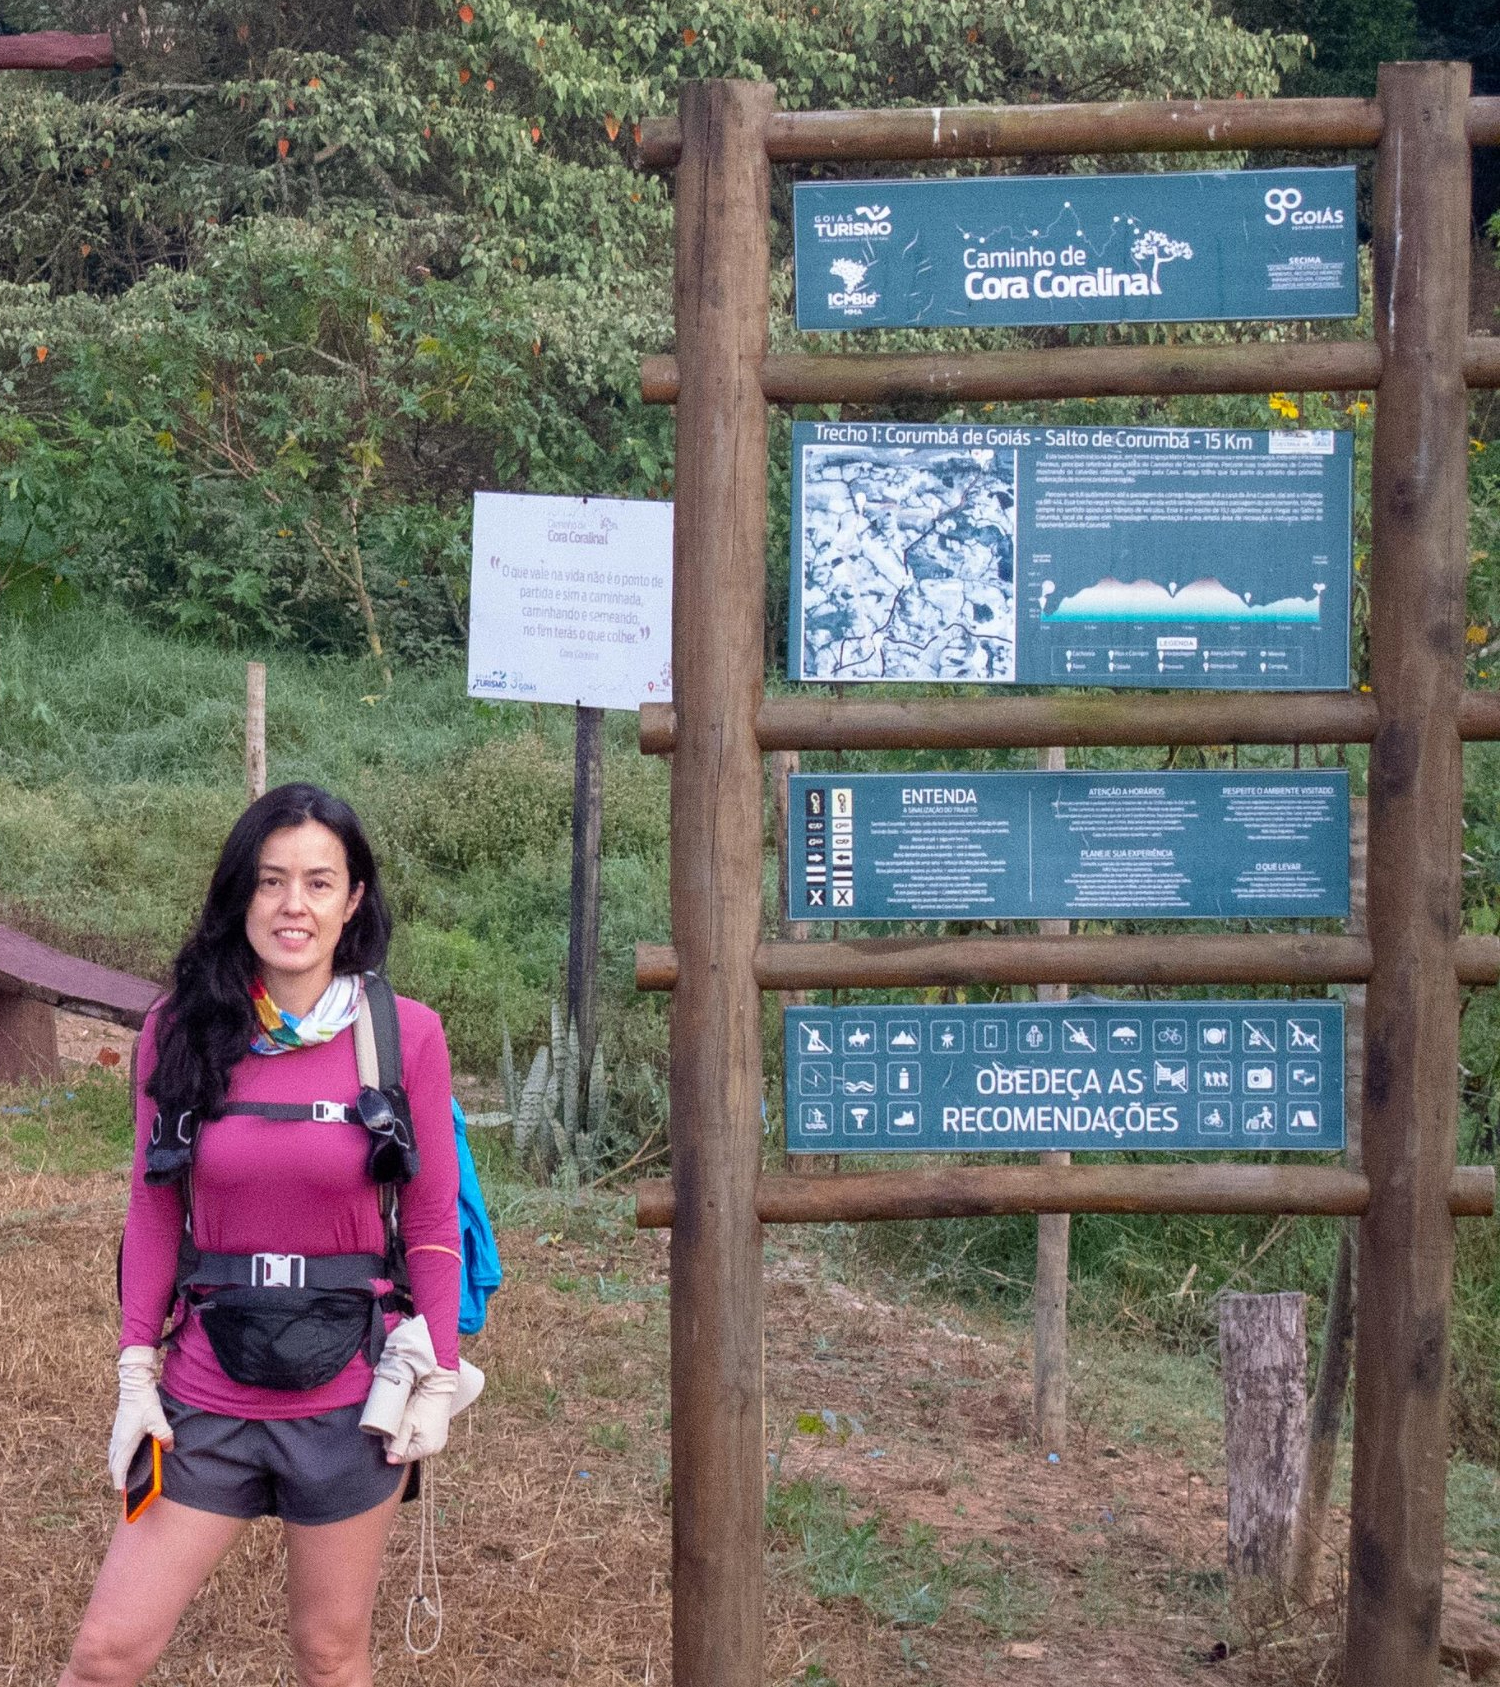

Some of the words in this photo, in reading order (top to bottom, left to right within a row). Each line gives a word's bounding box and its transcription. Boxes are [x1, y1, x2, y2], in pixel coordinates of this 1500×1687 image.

[814, 214, 853, 223] GOIÁS
[1291, 207, 1344, 224] GOIÁS
[814, 222, 892, 237] TURISMO
[963, 247, 1056, 268] Caminho
[1060, 245, 1086, 267] de
[965, 271, 1029, 300] Cora
[1033, 268, 1148, 299] Coralina
[815, 425, 868, 443] Trecho
[871, 427, 882, 443] 1:
[885, 426, 958, 444] Corumbá
[962, 428, 983, 445] de
[986, 427, 1031, 447] Goiás
[1045, 429, 1088, 448] Salto
[1092, 430, 1112, 448] de
[1115, 430, 1189, 449] Corumbá
[1203, 433, 1220, 449] 15
[1223, 433, 1253, 450] Km
[548, 530, 567, 542] Cora
[511, 568, 529, 581] que
[530, 566, 549, 580] vale
[552, 570, 563, 581] na
[565, 569, 585, 582] vida
[587, 571, 605, 584] não
[607, 571, 613, 584] é
[614, 574, 620, 585] o
[622, 574, 650, 588] ponto
[652, 575, 663, 588] de
[520, 586, 553, 600] partida
[556, 589, 561, 599] e
[563, 588, 579, 600] sim
[582, 590, 588, 600] a
[522, 605, 580, 621] caminhando
[582, 610, 587, 620] e
[524, 624, 534, 636] no
[537, 623, 552, 637] fim
[555, 625, 577, 639] terás
[580, 629, 585, 640] o
[587, 630, 605, 643] que
[475, 679, 506, 689] TURISMO
[902, 789, 977, 804] ENTENDA
[1089, 788, 1120, 796] ATENÇÃO
[1128, 787, 1165, 795] HORÁRIOS
[1223, 787, 1256, 795] RESPEITE
[1128, 848, 1172, 857] EXPERIÊNCIA
[1262, 863, 1277, 871] QUE
[976, 1068, 1101, 1100] OBEDEÇA
[1108, 1068, 1144, 1092] AS
[942, 1102, 1179, 1137] RECOMENDAÇÕES
